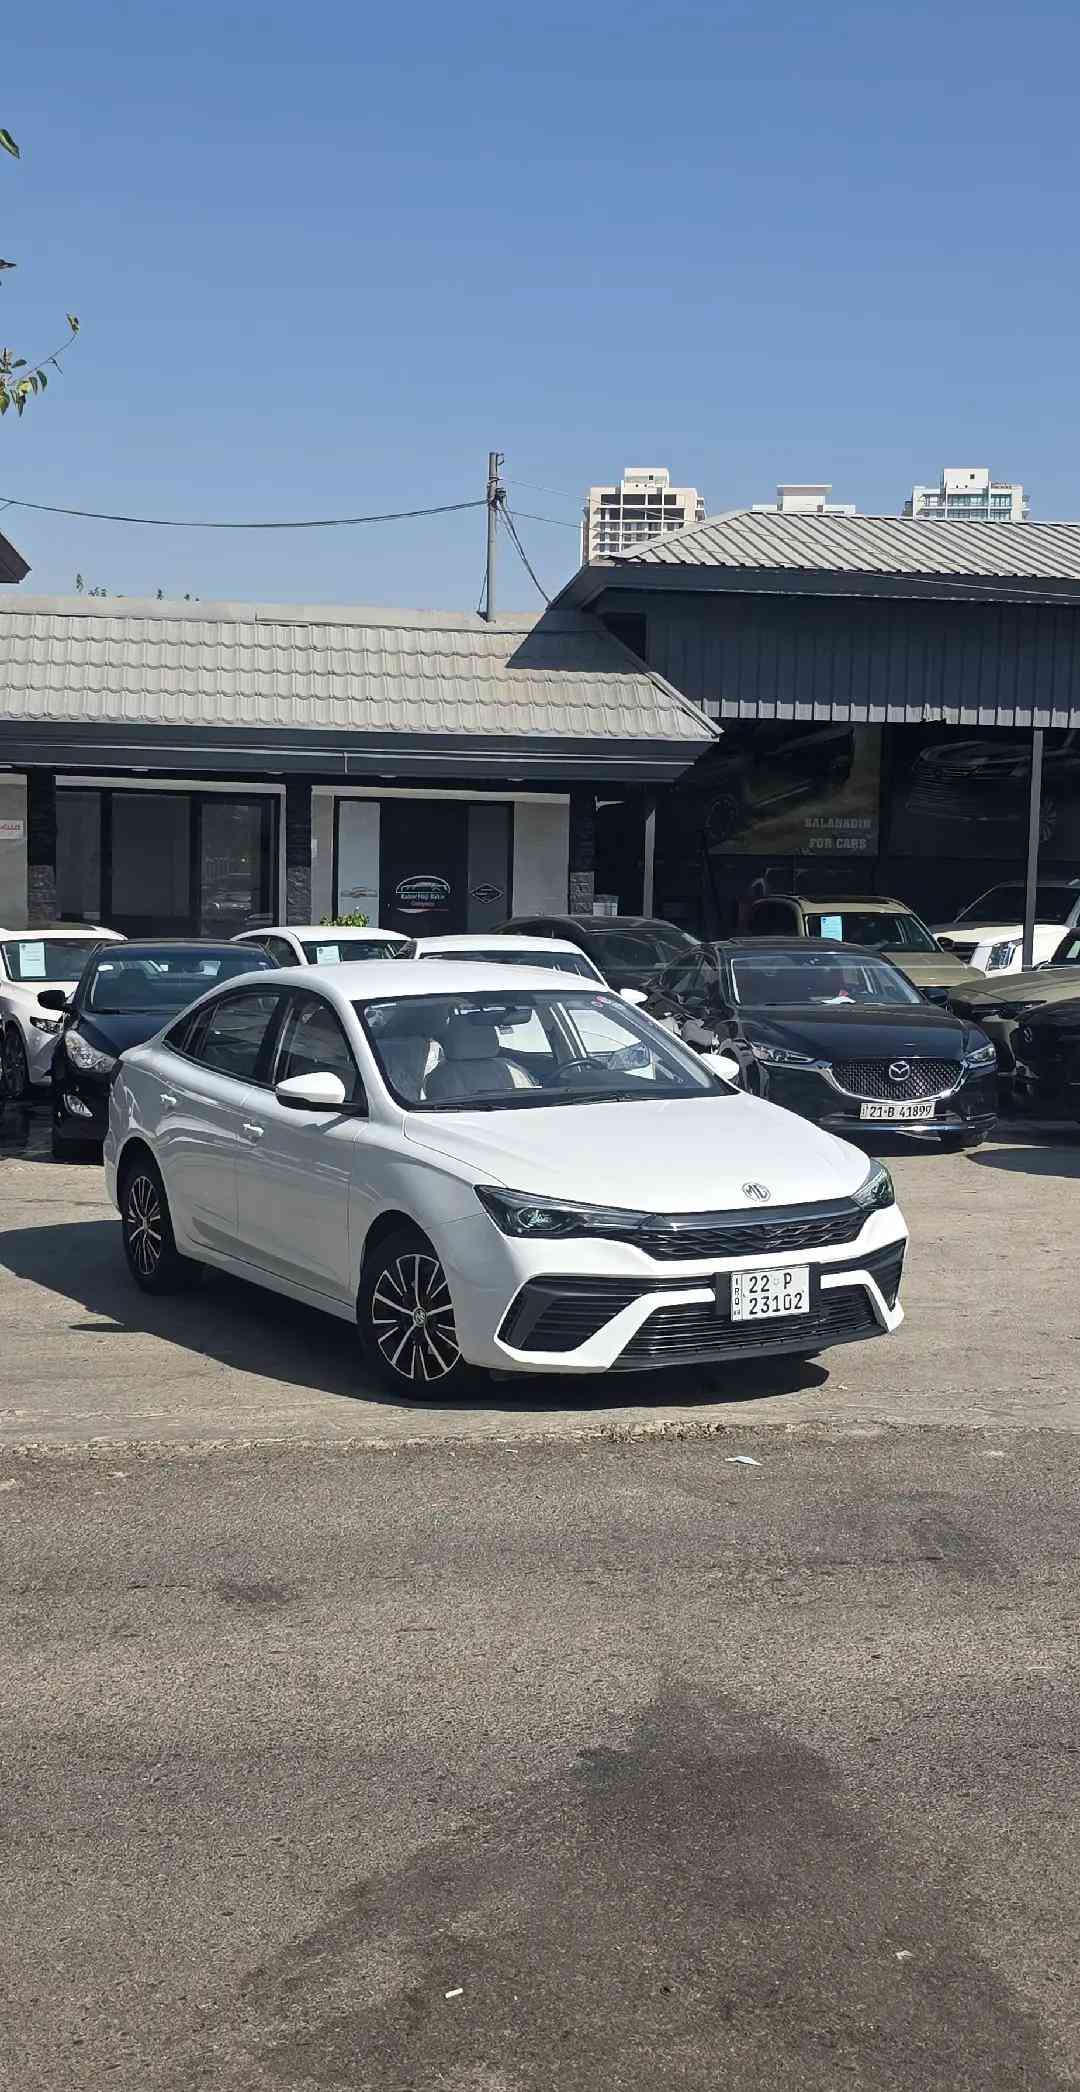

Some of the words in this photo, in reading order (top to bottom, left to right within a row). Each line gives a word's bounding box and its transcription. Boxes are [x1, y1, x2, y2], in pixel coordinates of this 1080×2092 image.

[809, 838, 833, 849] FOR
[835, 838, 867, 849] CARS
[742, 1183, 771, 1202] MG
[749, 1275, 770, 1294] 22
[783, 1272, 792, 1290] P
[749, 1292, 803, 1316] 23102
